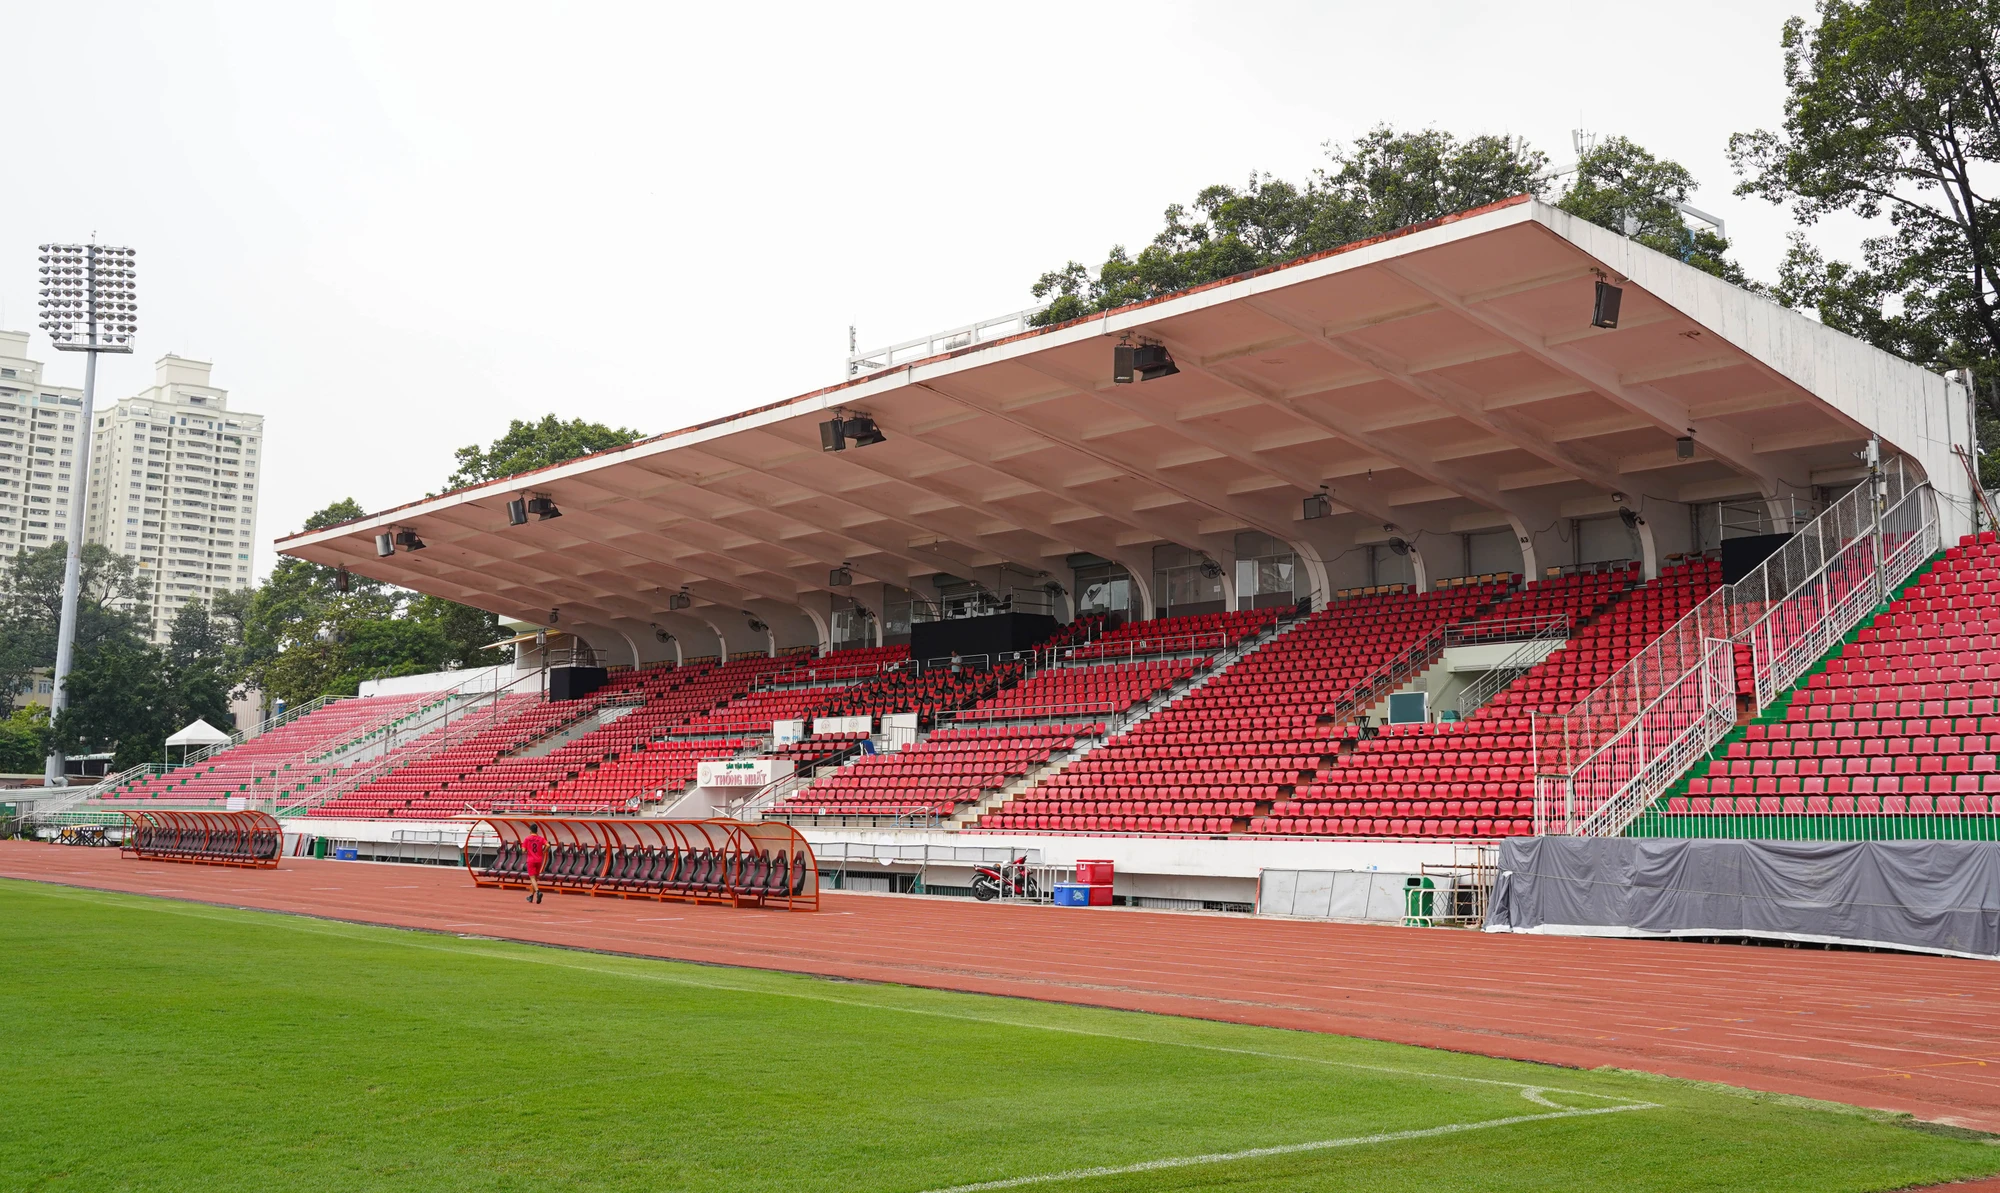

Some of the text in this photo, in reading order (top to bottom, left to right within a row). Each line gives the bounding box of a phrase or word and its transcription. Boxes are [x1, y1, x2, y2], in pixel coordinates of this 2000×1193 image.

[714, 769, 767, 785] THỐNG NHẤT
[532, 842, 538, 854] 8
